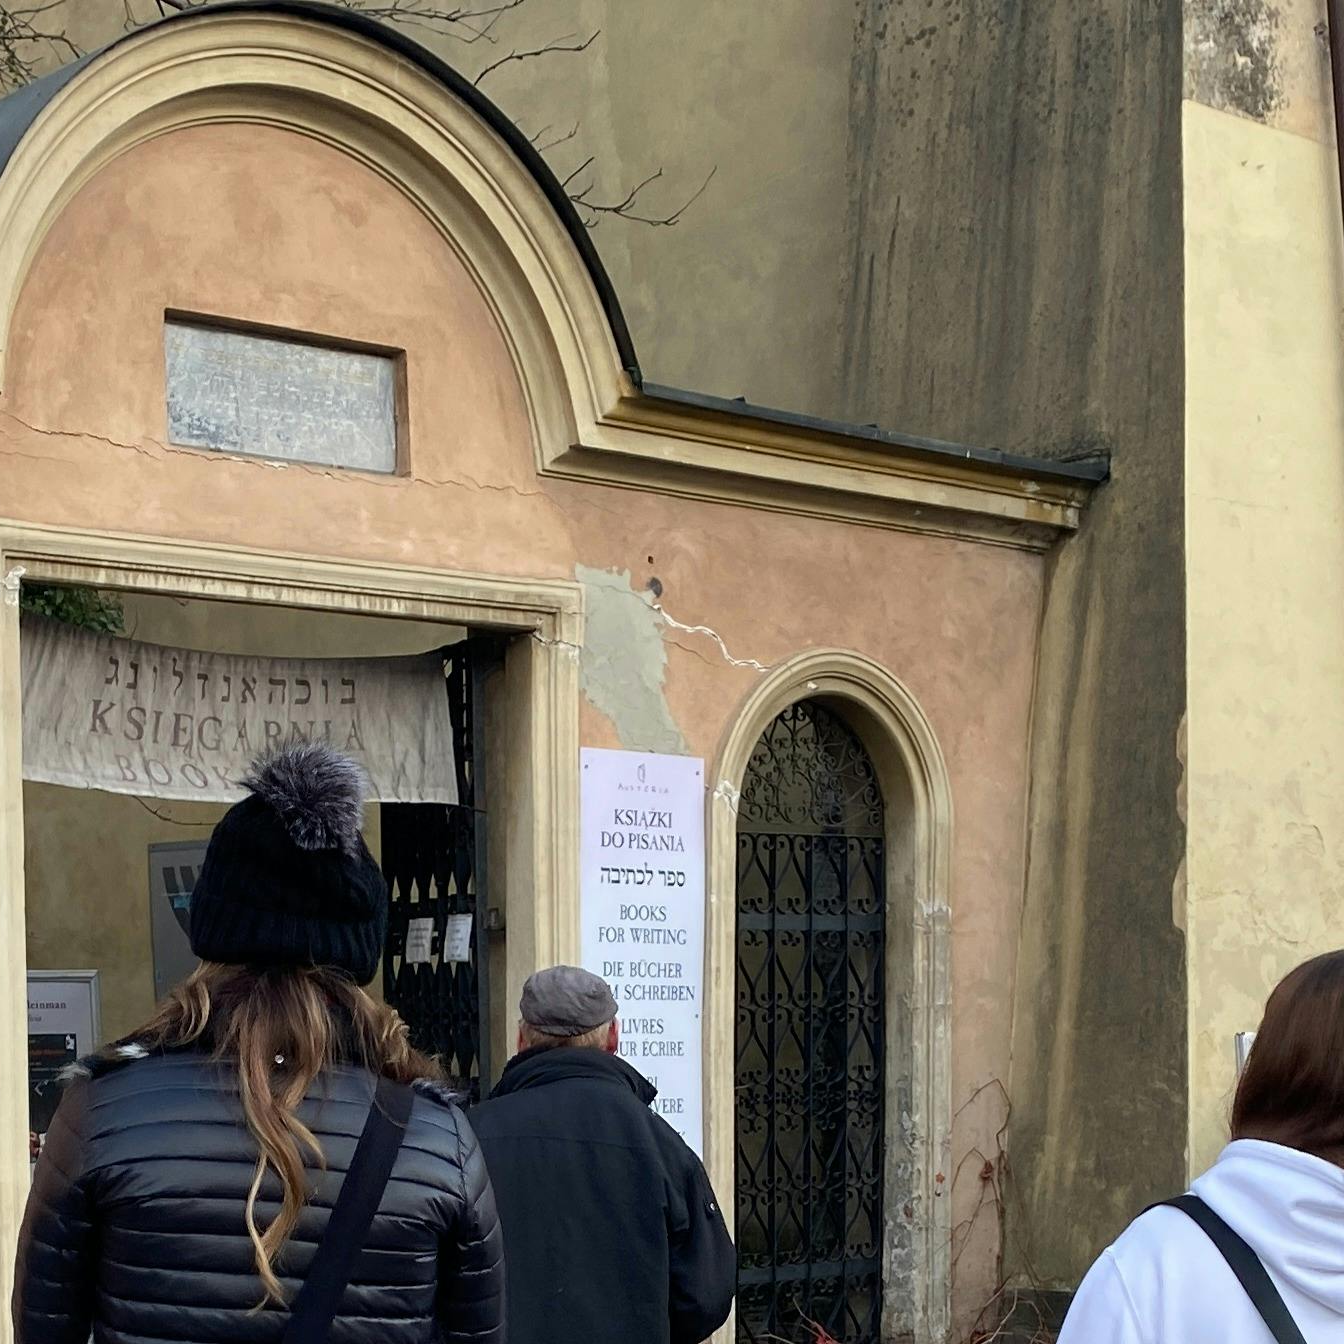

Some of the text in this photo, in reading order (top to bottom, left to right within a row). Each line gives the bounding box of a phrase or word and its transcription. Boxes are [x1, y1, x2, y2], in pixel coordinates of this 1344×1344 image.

[104, 655, 356, 704] בוכהאנדלונג
[614, 808, 673, 830] KSIĄŻKI
[600, 831, 685, 852] DO PISANIA
[601, 862, 686, 887] ספר לכתיבה
[619, 904, 668, 922] BOOKS
[598, 926, 687, 945] FOR WRITING
[602, 959, 683, 978] DIE BÜCHER
[623, 984, 696, 1001] SCHREIBEN
[621, 1018, 664, 1035] LIVRES
[642, 1038, 685, 1057] ÉCRIRE
